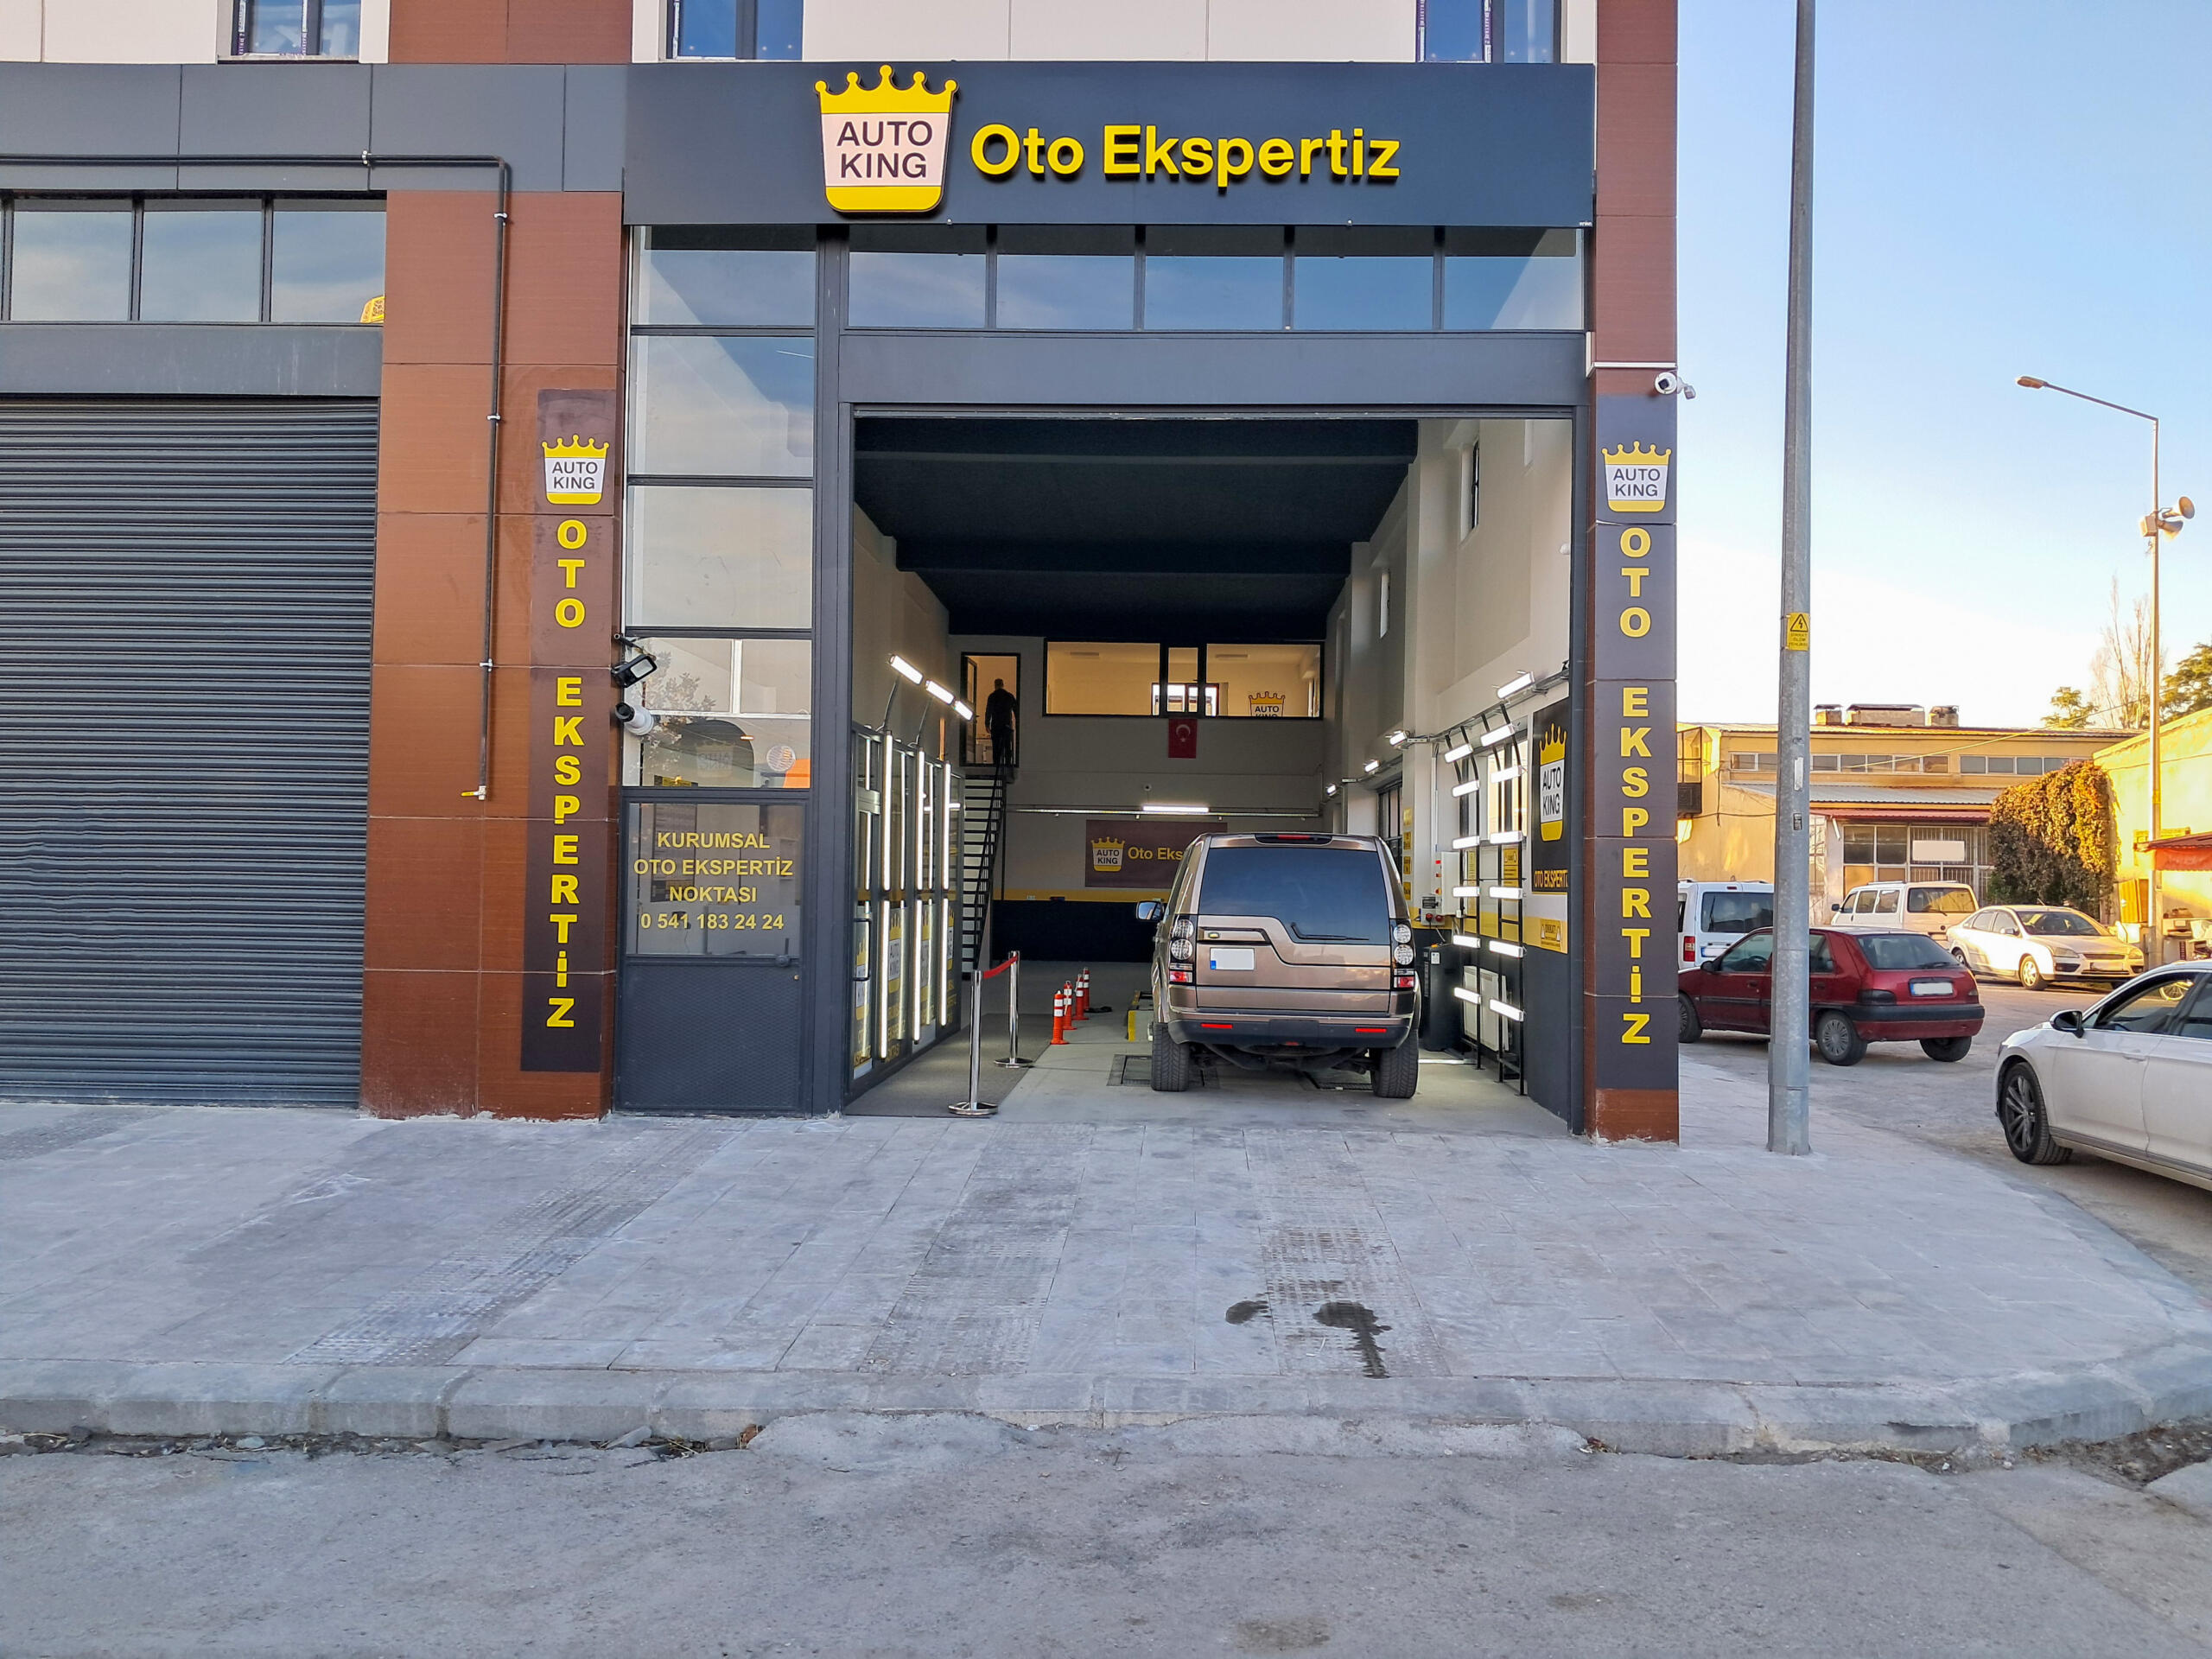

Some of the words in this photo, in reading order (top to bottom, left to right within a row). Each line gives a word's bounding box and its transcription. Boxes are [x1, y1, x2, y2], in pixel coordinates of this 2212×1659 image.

[836, 120, 933, 147] AUTO
[969, 124, 1085, 177] Oto
[1103, 124, 1401, 188] Ekspertiz
[840, 152, 927, 179] KING
[551, 461, 598, 474] AUTO
[1612, 467, 1661, 481] AUTO
[553, 476, 595, 490] KING
[1614, 484, 1658, 497] KING
[555, 519, 588, 628] OTO
[1619, 527, 1651, 638] OTO
[1542, 766, 1561, 791] AUTO
[1543, 793, 1560, 816] KING
[657, 832, 771, 849] KURUMSAL
[1128, 847, 1154, 860] Oto
[1157, 847, 1184, 861] Eks
[633, 859, 677, 875] OTO
[669, 885, 757, 902] NOKTASI
[640, 913, 652, 929] 0
[658, 913, 689, 929] 541
[697, 913, 728, 930] 183
[734, 914, 756, 930] 24
[762, 914, 784, 930] 24
